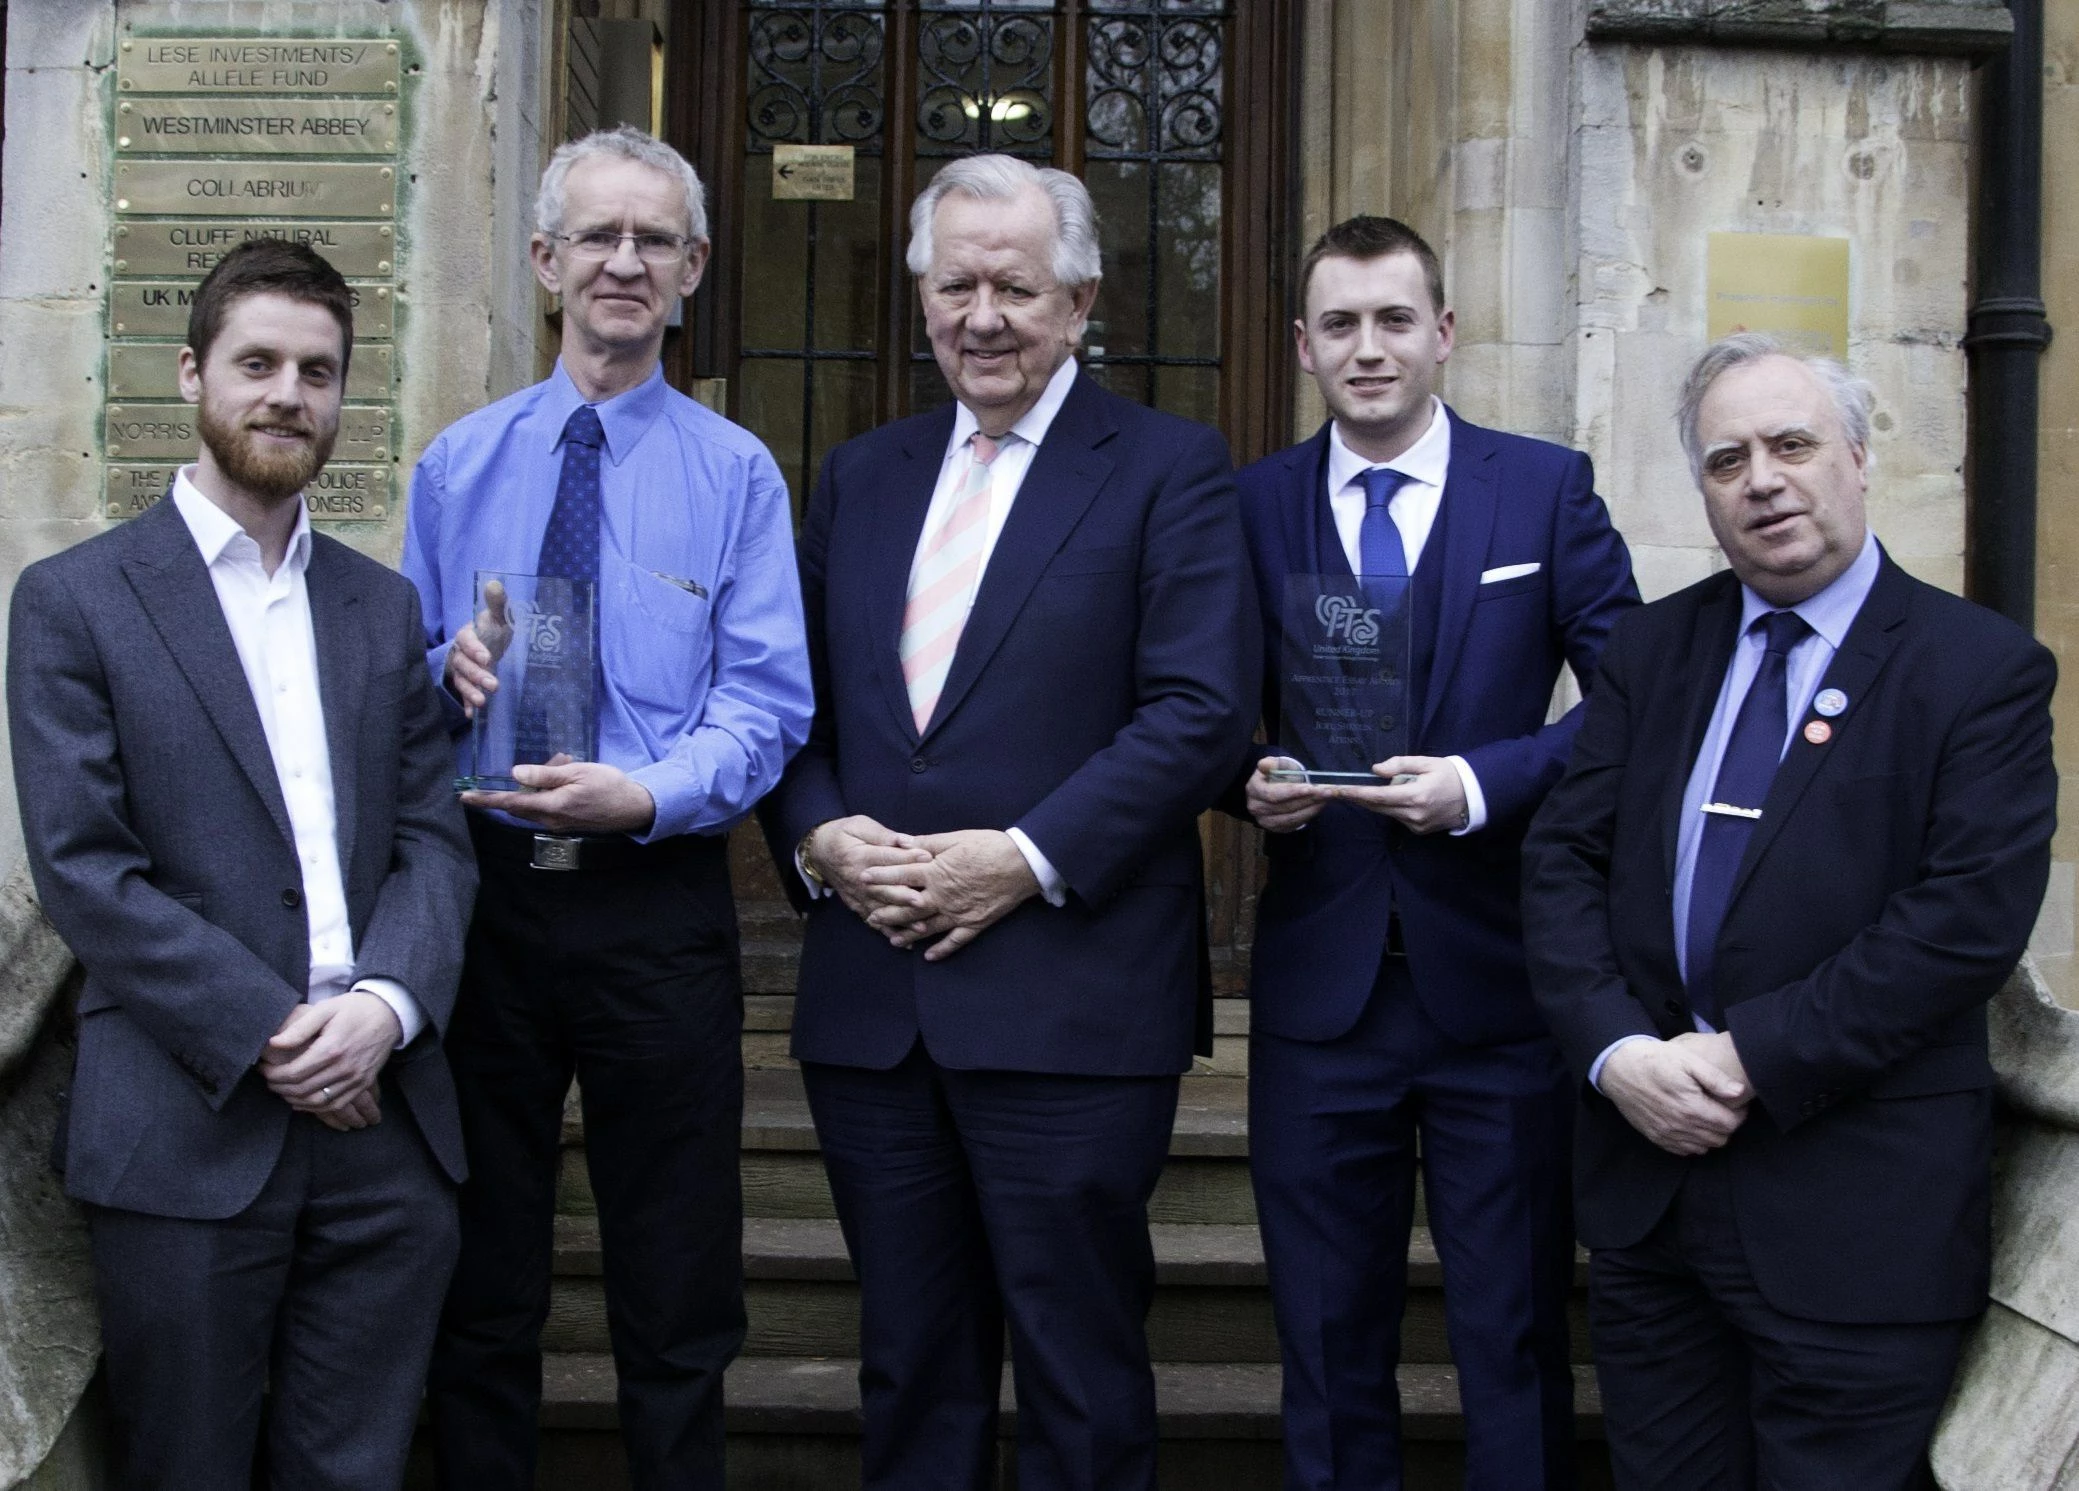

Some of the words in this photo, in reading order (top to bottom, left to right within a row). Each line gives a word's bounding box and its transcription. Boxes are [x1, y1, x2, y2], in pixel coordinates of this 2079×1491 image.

[147, 46, 200, 63] LESE
[209, 46, 367, 65] INVESTMENTS/
[187, 70, 264, 87] ALLELE
[272, 70, 329, 87] FUND
[143, 116, 295, 135] WESTMINSTER
[300, 117, 370, 136] ABBEY
[170, 228, 237, 246] CLUFF
[244, 229, 338, 246] NATURAL
[143, 289, 170, 306] UK
[129, 470, 161, 488] THE
